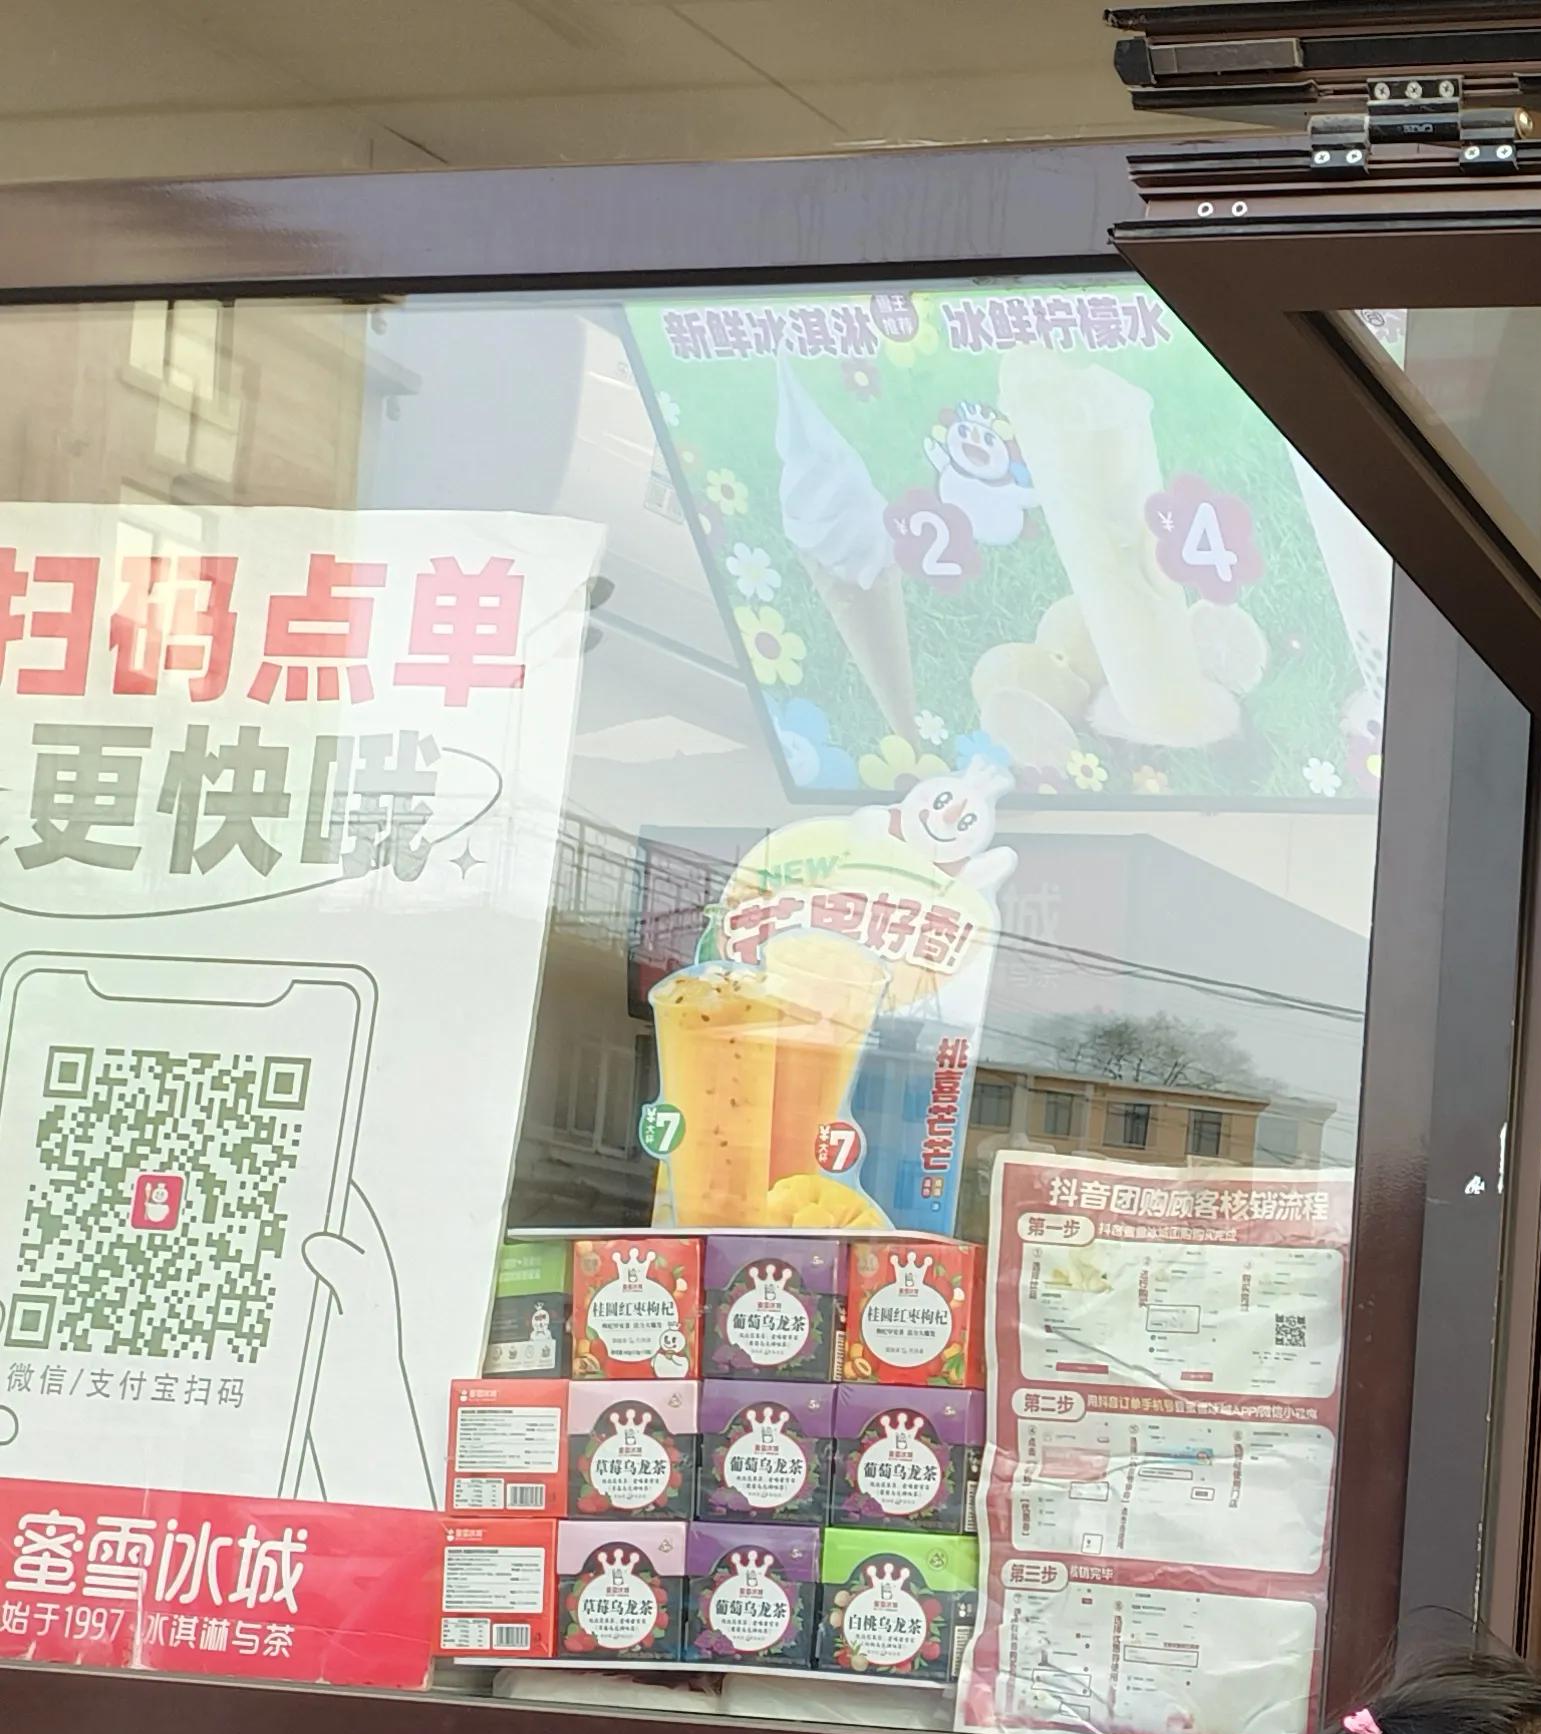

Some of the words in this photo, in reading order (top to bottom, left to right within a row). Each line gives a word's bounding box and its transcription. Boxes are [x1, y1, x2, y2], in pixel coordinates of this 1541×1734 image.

[664, 308, 878, 360] 新鲜冰淇淋
[943, 295, 1170, 352] 冰鲜柠檬水
[0, 548, 526, 708] 扫码点单
[15, 723, 441, 882] 更快哦
[757, 855, 840, 892] NEW
[1049, 1175, 1329, 1222] 抖音团购顾客核销流程
[1028, 1216, 1081, 1239] 第一步
[732, 1313, 807, 1332] 葡萄乌龙茶
[4, 1361, 246, 1408] 微信/支付宝扫码
[1024, 1392, 1075, 1414] 第二步
[595, 1459, 668, 1477] 草莓乌龙茶
[729, 1456, 803, 1476] 葡萄乌龙茶
[864, 1461, 938, 1482] 葡萄乌龙茶
[5, 1509, 310, 1614] 蜜雪冰城
[1009, 1564, 1058, 1585] 第三步
[582, 1598, 654, 1617] 草莓乌龙茶
[716, 1599, 787, 1618] 葡萄乌龙茶
[0, 1600, 125, 1643] 始于1997
[849, 1613, 923, 1635] 白桃乌龙茶
